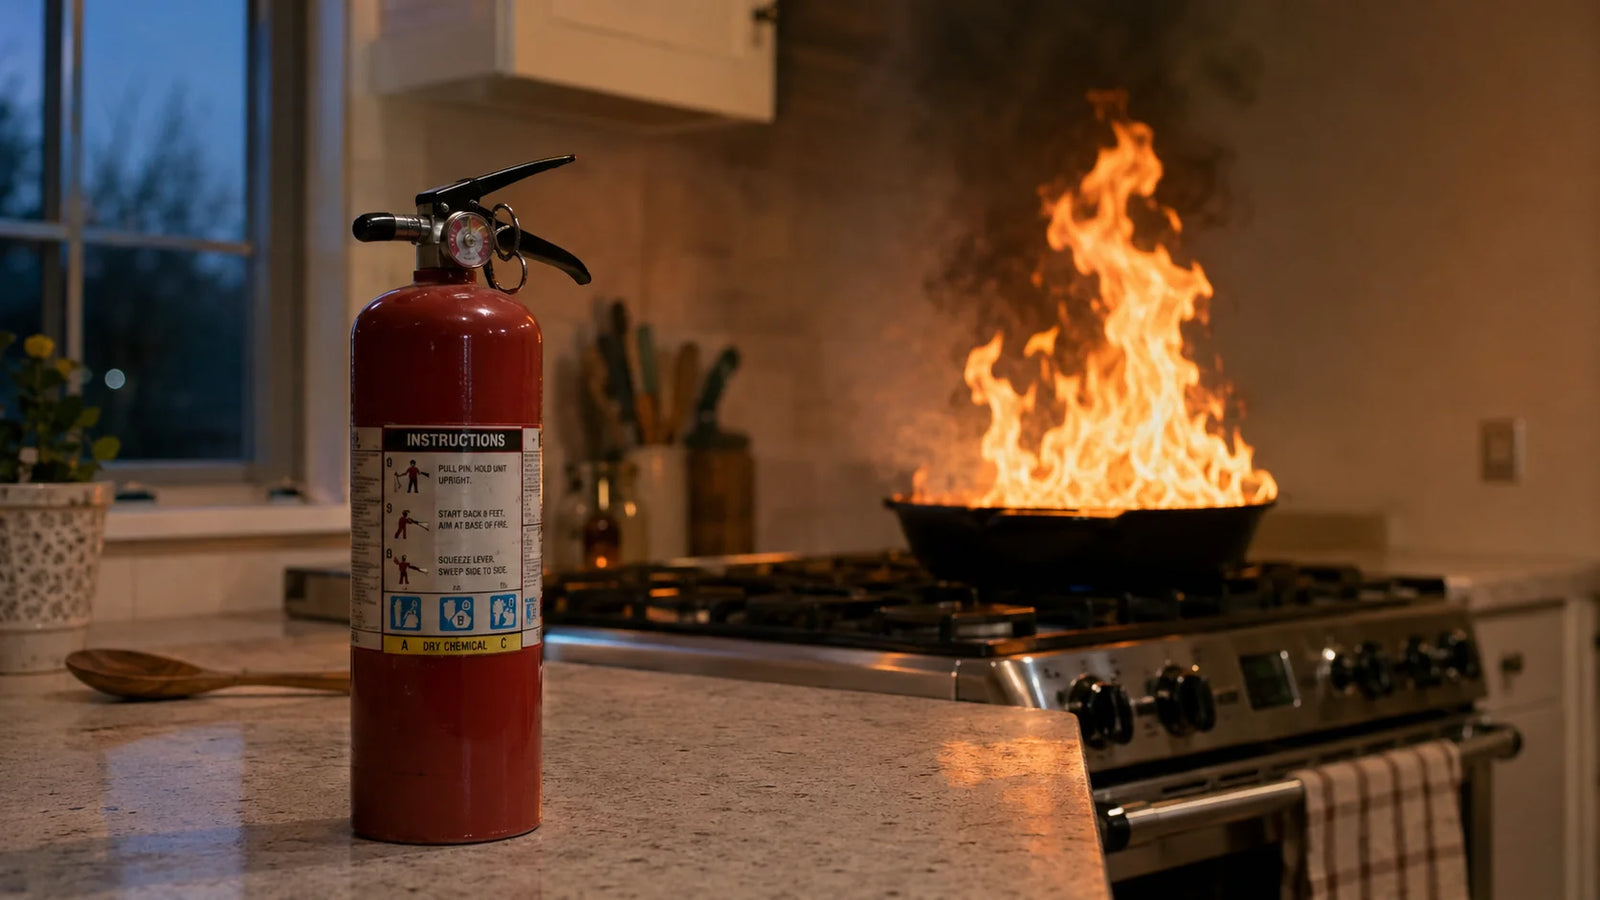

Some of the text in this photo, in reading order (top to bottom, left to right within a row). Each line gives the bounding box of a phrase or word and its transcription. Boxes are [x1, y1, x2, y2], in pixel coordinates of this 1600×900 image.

[406, 433, 505, 447] INSTRUCTIONS
[438, 464, 457, 473] PULL
[474, 464, 491, 473] HOLD
[493, 464, 507, 473] UNIT
[438, 476, 472, 485] UPRIGHT.
[438, 510, 461, 518] START
[463, 509, 482, 518] BACK
[438, 521, 453, 530] AIM
[454, 521, 463, 530] AT
[465, 521, 483, 529] BASE
[485, 520, 493, 529] OF
[438, 555, 471, 564] SQUEEZE
[438, 567, 464, 576] SWEEP
[465, 567, 481, 575] SIDE
[483, 566, 491, 575] TO
[457, 615, 464, 626] B
[401, 637, 507, 651] A DRY CHEMICAL C
